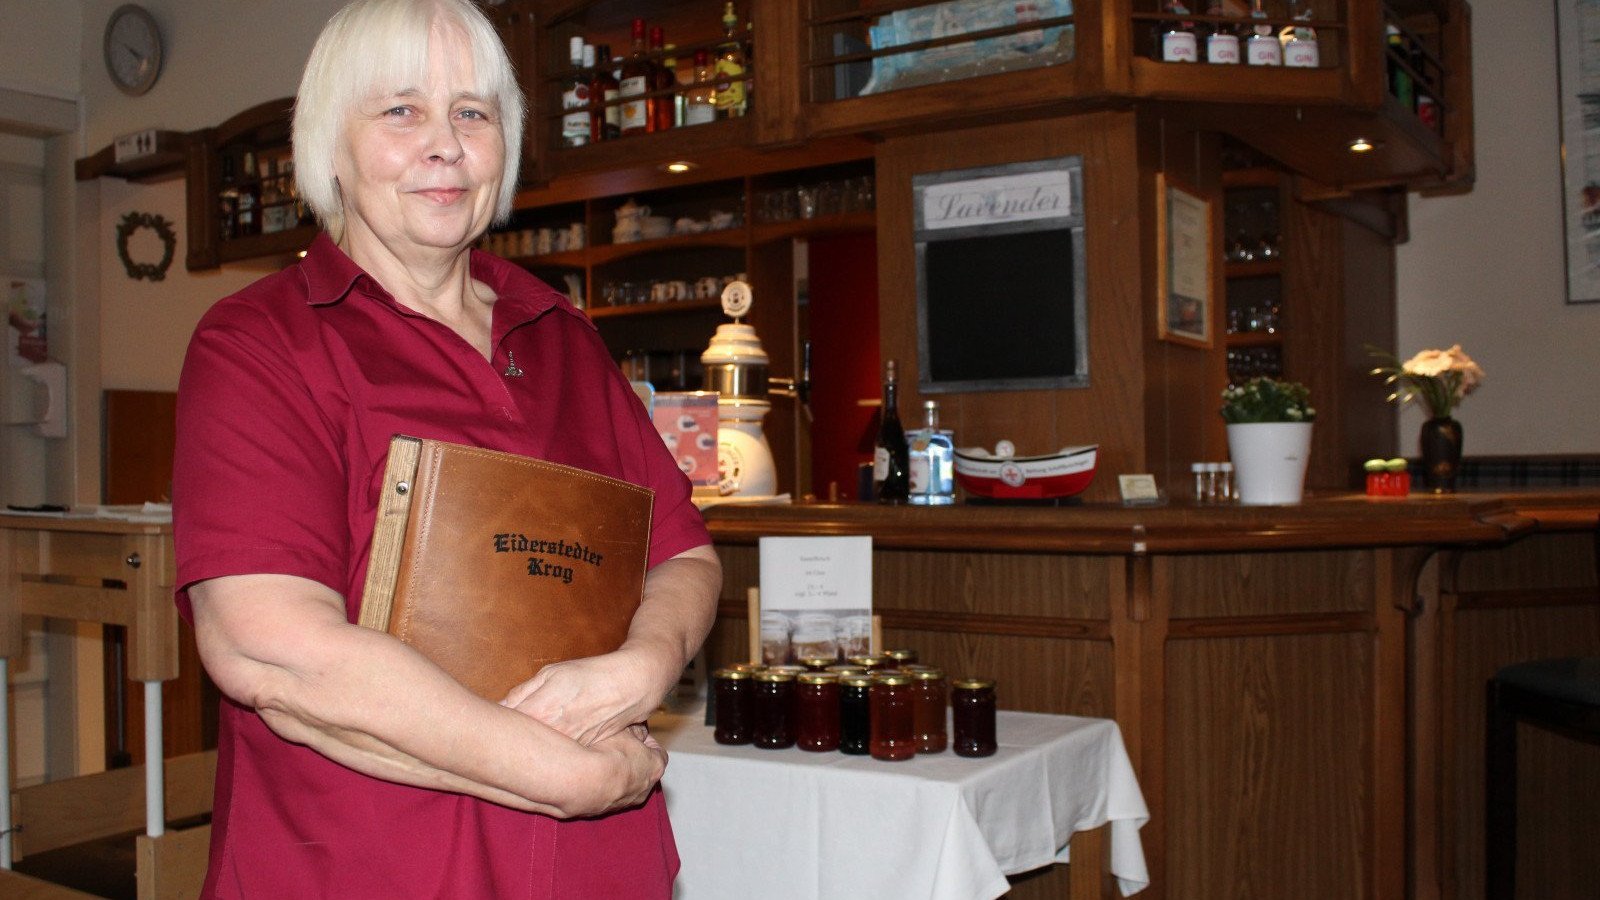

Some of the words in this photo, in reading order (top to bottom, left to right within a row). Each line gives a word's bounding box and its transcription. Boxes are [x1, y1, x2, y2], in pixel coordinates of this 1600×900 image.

[1172, 46, 1192, 56] GIN
[1217, 50, 1236, 60] GIN
[1257, 51, 1276, 61] GIN
[1294, 54, 1313, 64] GIN
[936, 186, 1061, 221] Lavender
[493, 533, 603, 567] Eiderstedter
[527, 557, 574, 584] Krog
